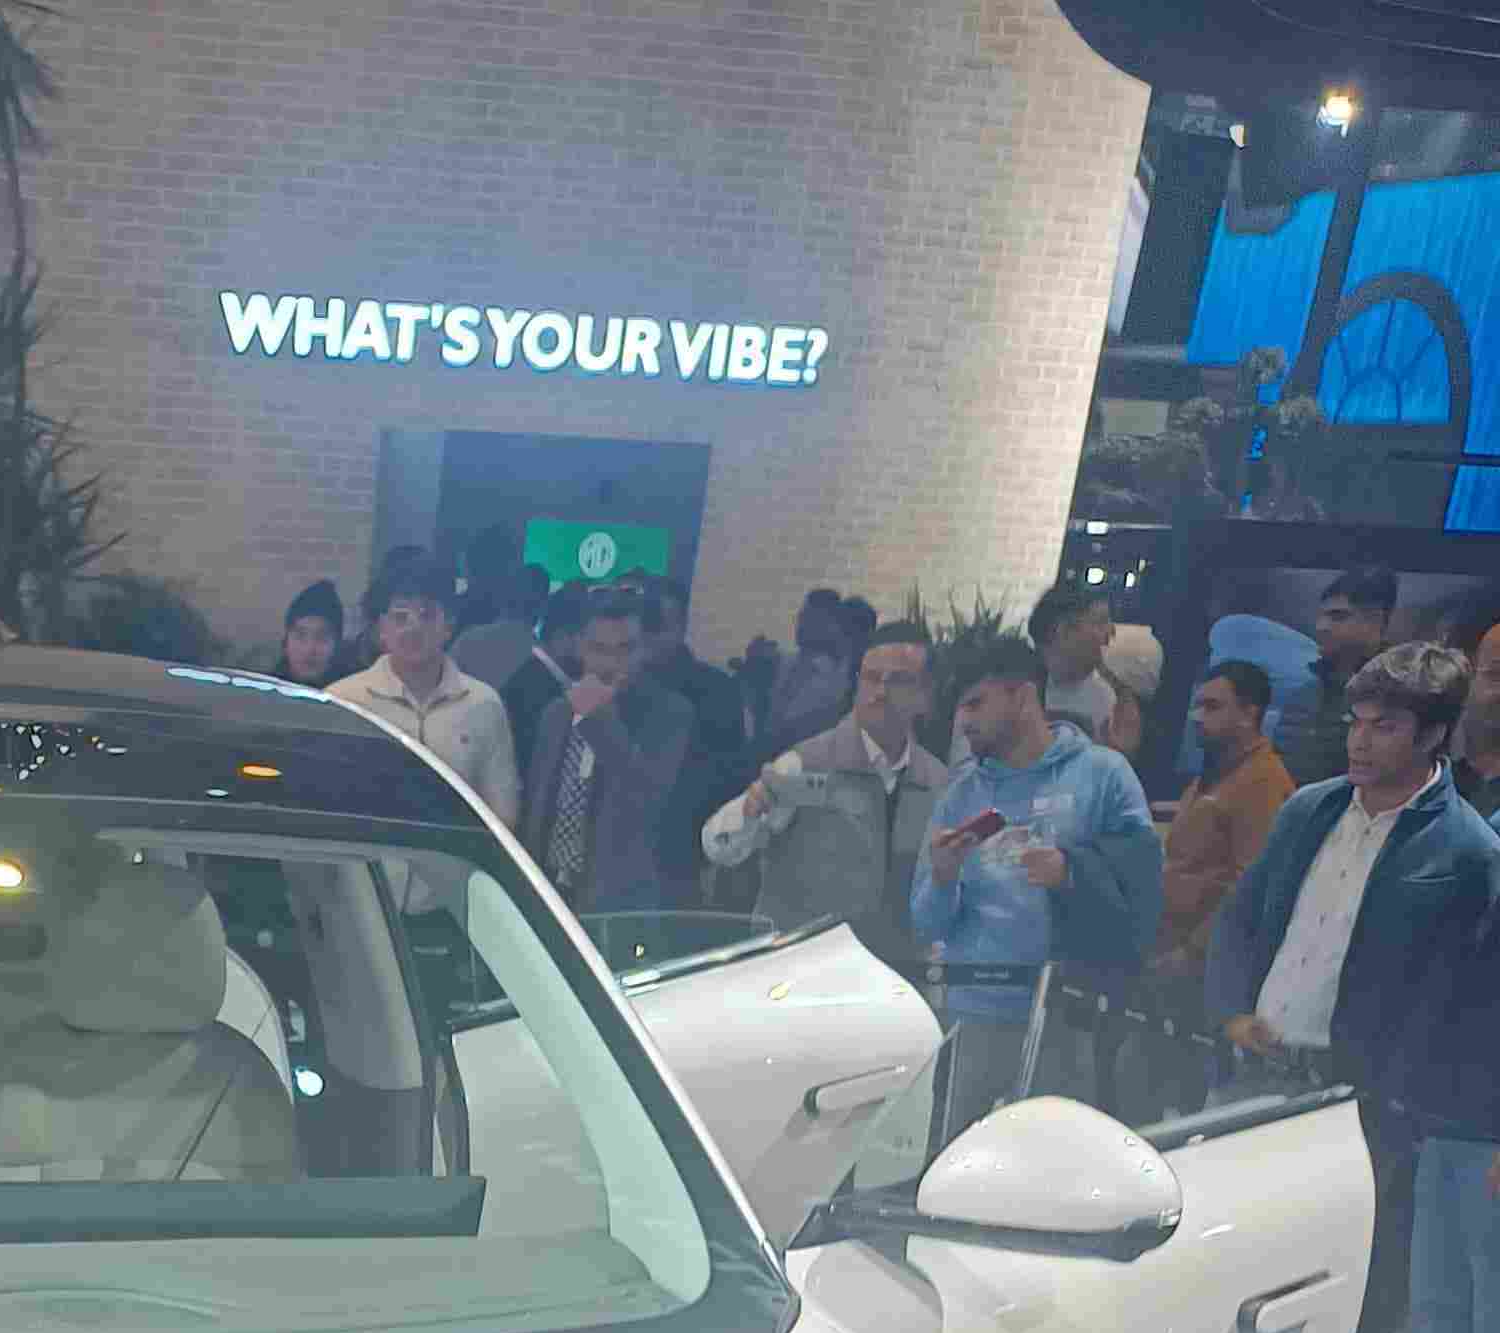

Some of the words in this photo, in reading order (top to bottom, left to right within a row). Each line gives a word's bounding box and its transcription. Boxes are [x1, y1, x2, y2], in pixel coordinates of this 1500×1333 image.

[220, 291, 481, 366] WHAT'S
[485, 307, 662, 375] YOUR
[669, 320, 829, 384] VIBE?
